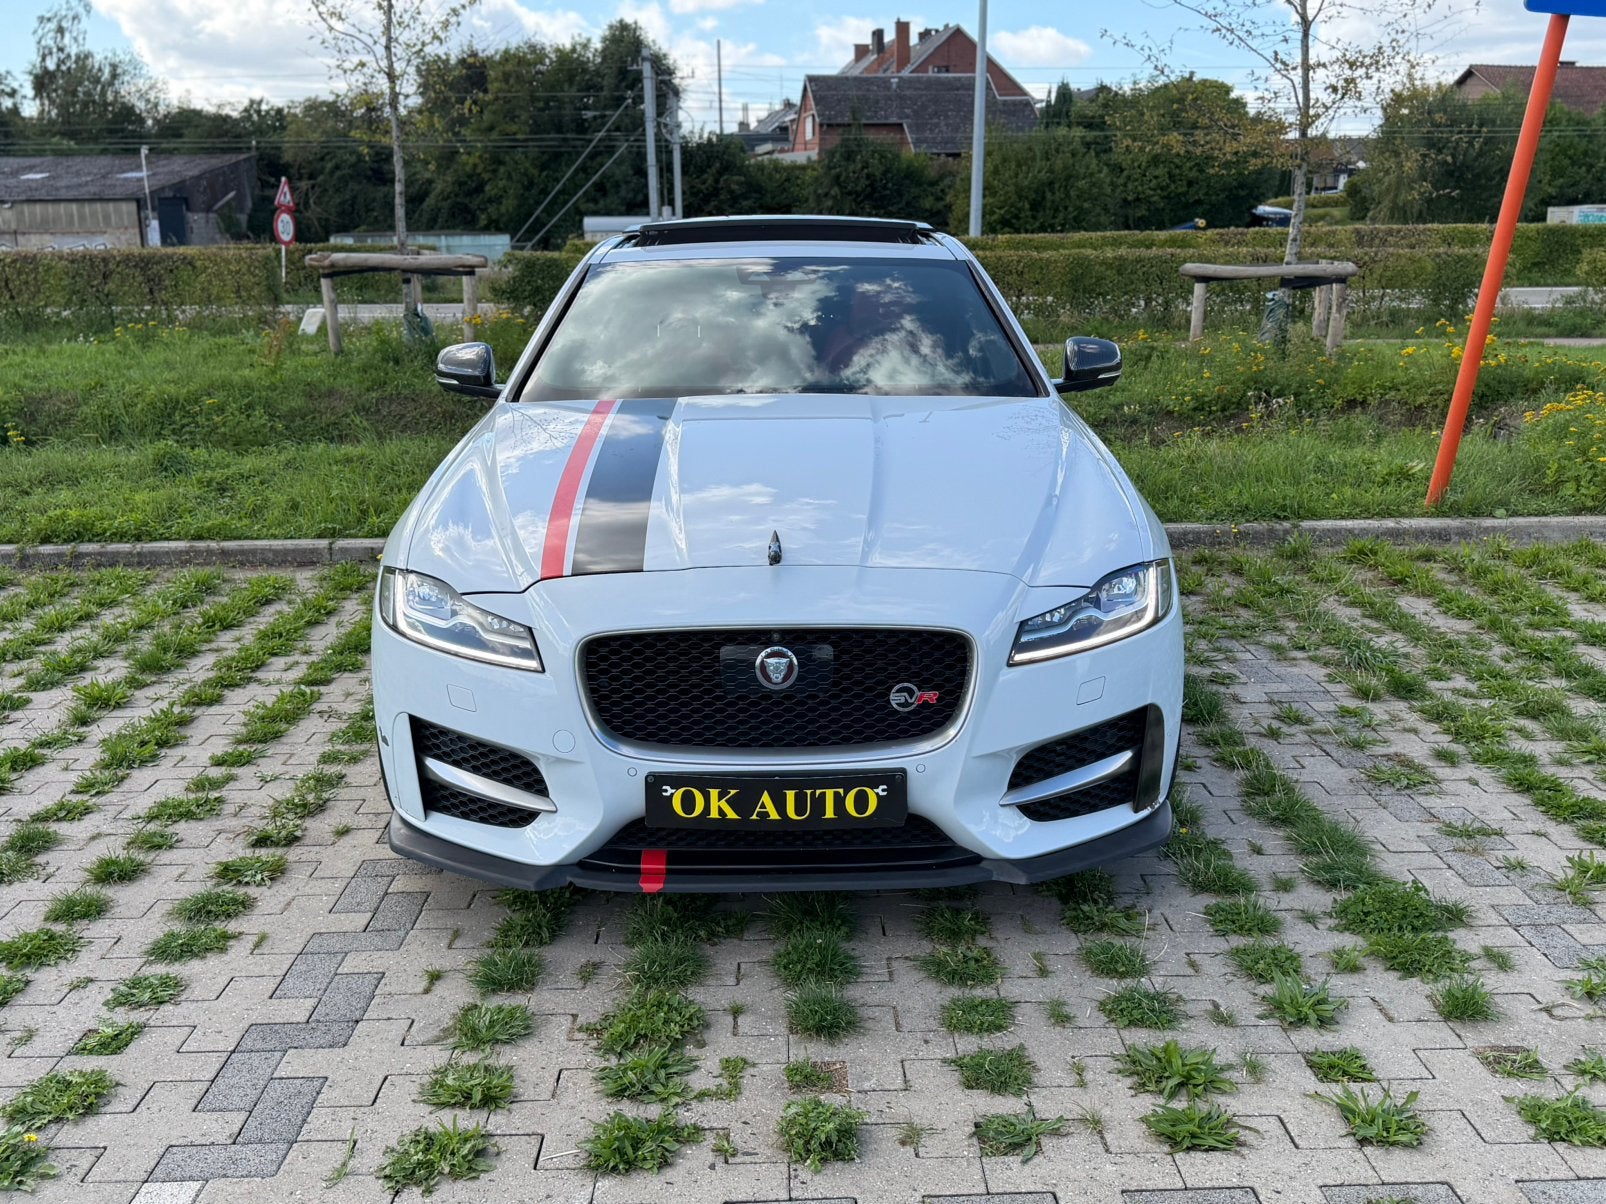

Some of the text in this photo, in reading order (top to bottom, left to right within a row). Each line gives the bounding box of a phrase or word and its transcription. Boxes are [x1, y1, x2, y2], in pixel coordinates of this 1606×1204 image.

[280, 218, 292, 236] 30
[890, 690, 939, 705] SVR
[672, 786, 878, 820] OK AUTO
